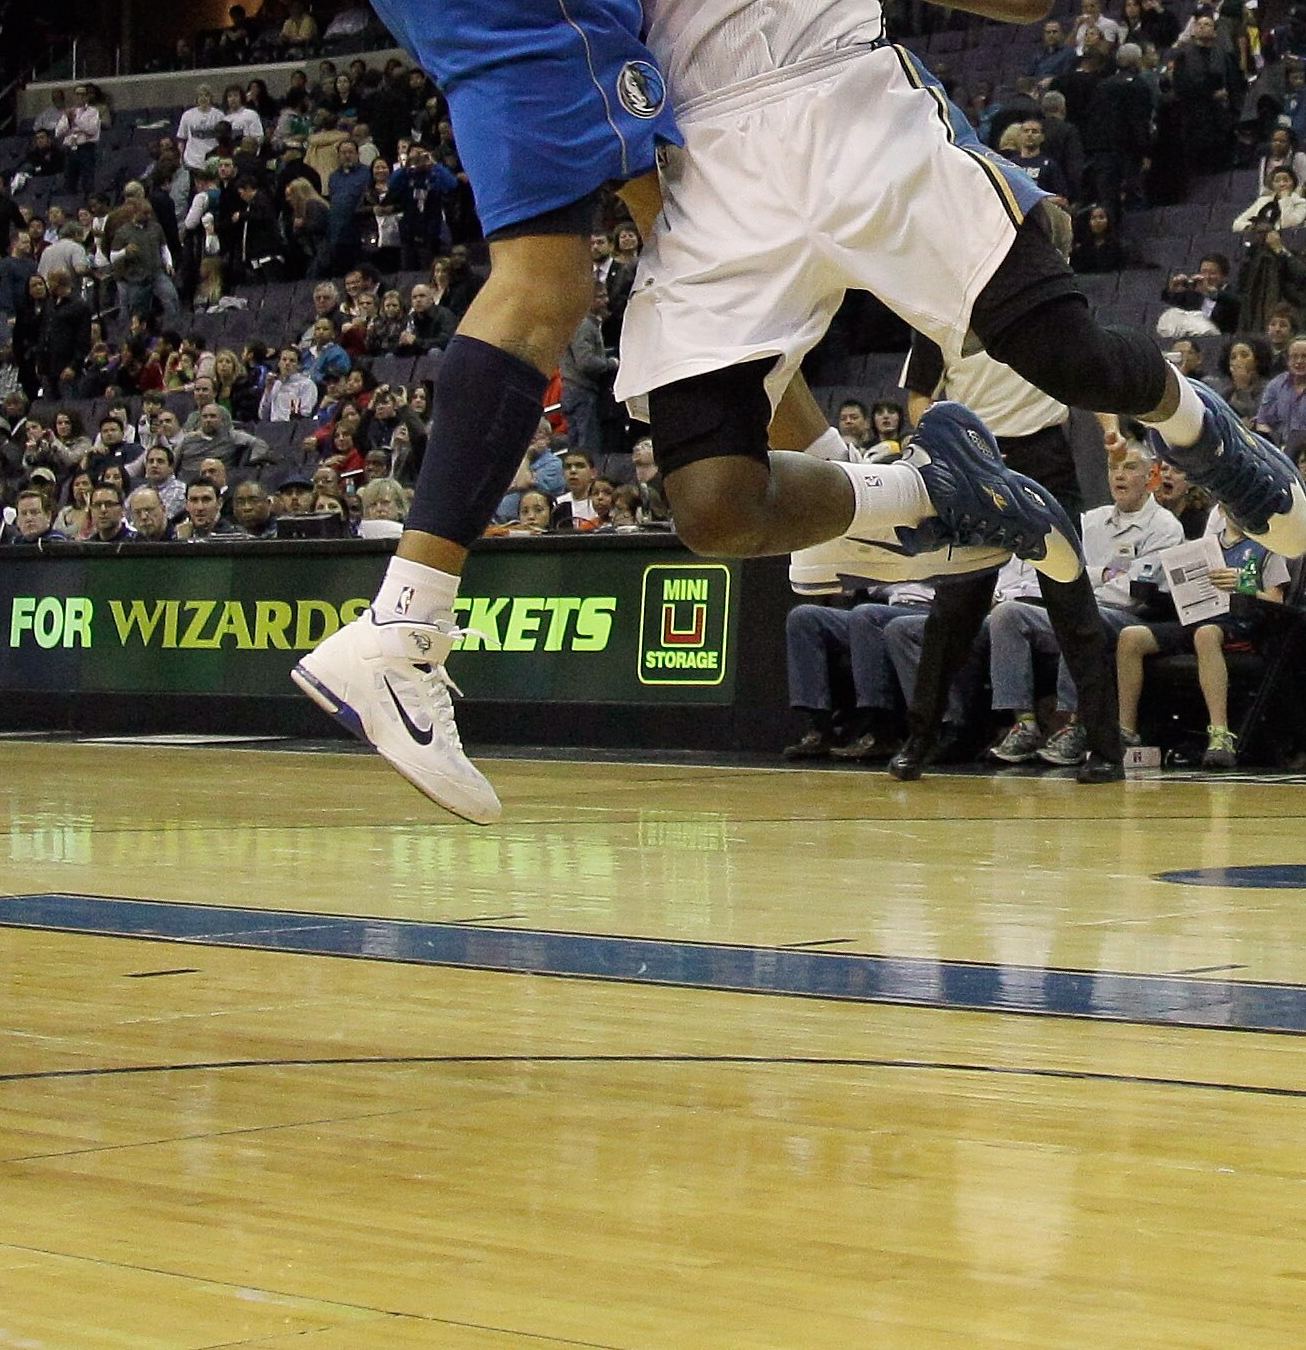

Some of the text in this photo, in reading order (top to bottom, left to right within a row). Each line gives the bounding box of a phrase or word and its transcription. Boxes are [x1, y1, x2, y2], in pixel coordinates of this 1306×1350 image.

[663, 578, 709, 601] MINI
[9, 596, 93, 649] FOR
[453, 597, 617, 652] KETS
[660, 603, 707, 648] U
[645, 650, 719, 669] STORAGE
